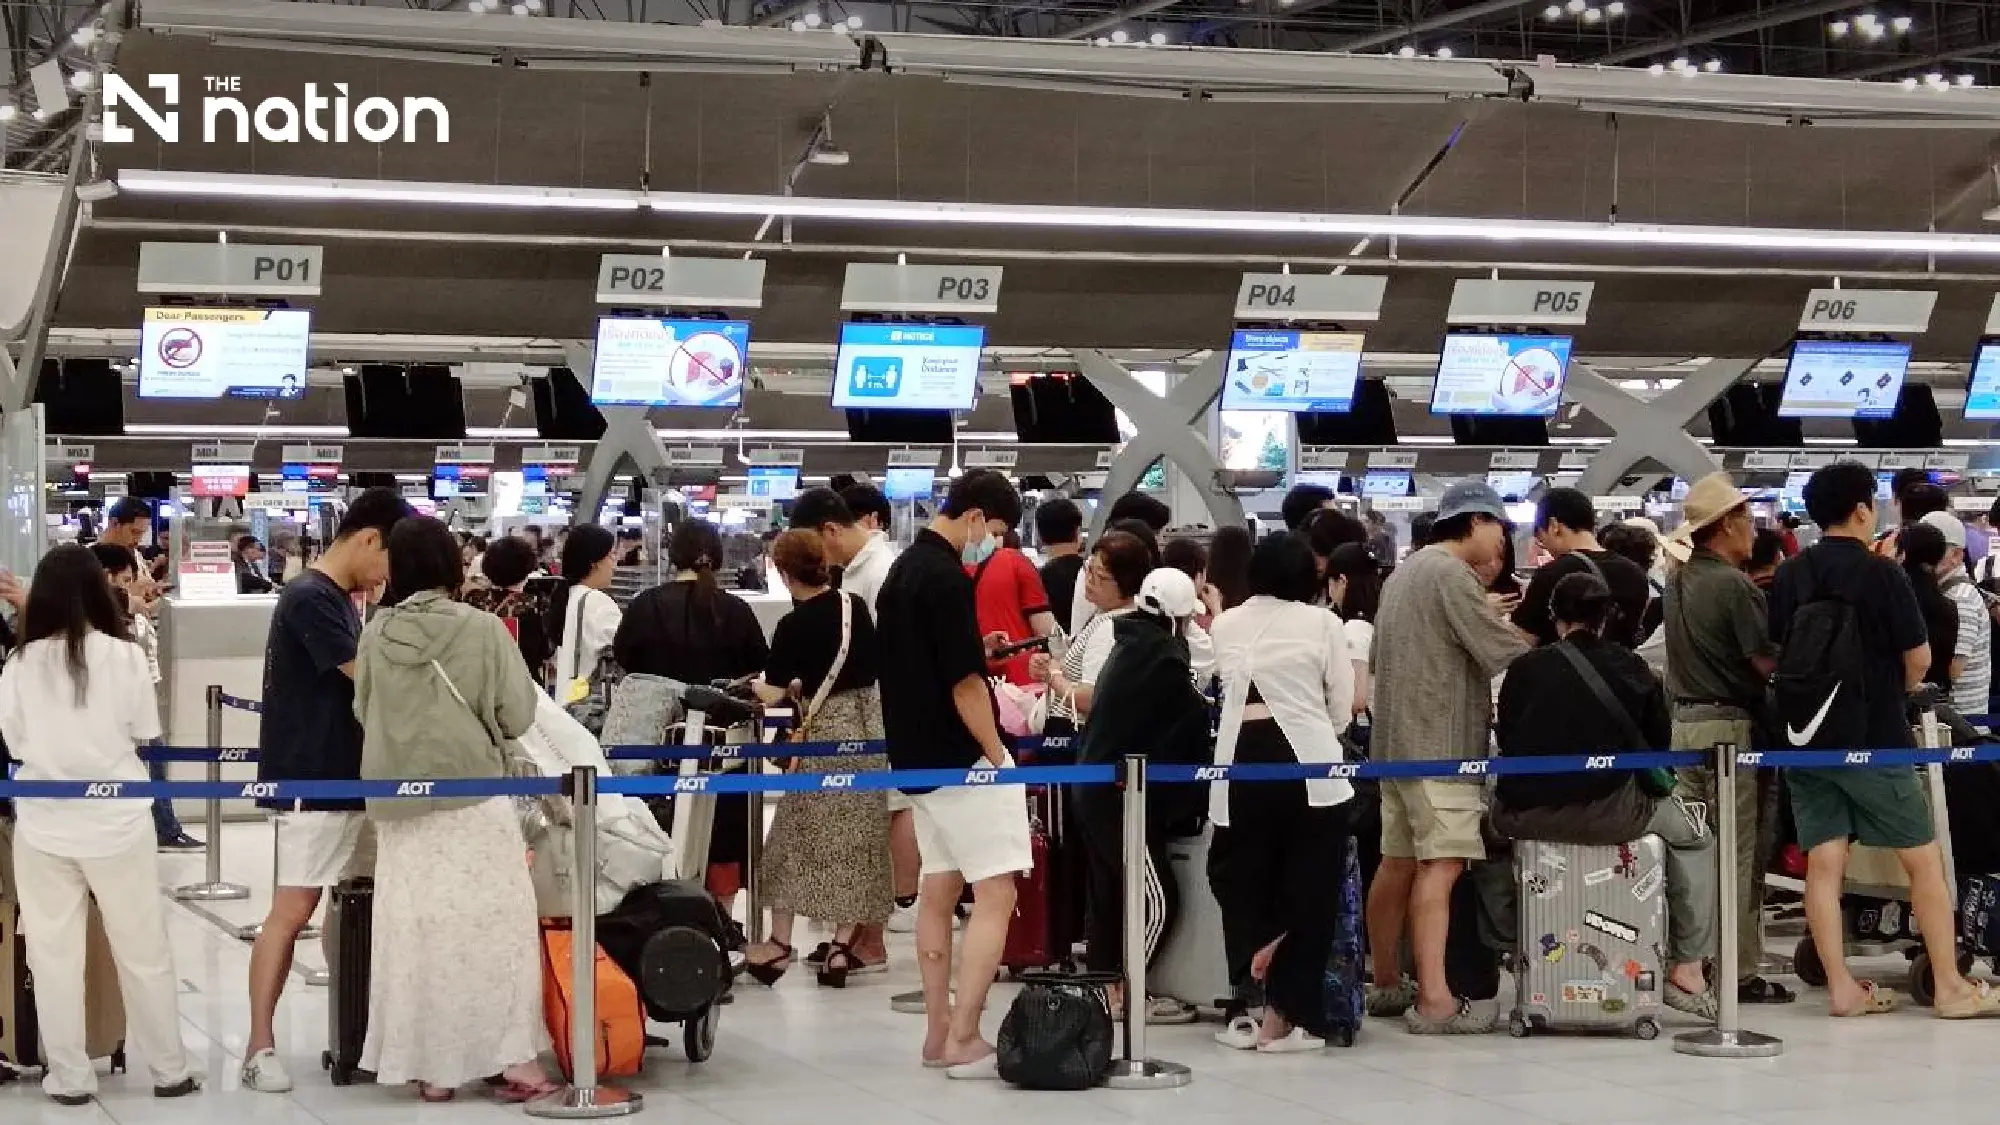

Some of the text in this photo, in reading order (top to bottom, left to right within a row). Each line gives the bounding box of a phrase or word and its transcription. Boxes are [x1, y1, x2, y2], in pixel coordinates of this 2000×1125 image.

[254, 256, 309, 281] P01
[610, 266, 665, 290] P02
[937, 277, 989, 300] P03
[1248, 284, 1296, 306] P04
[1533, 291, 1582, 312] P05
[156, 310, 246, 323] Dear Passengers
[1811, 300, 1857, 320] P06
[196, 448, 218, 457] M04
[837, 741, 867, 753] AOT
[1042, 736, 1071, 747] AOT
[218, 748, 249, 760] AOT
[710, 745, 741, 757] AOT
[1951, 747, 1976, 760] AOT
[1585, 756, 1616, 769] AOT
[1736, 752, 1764, 764] AOT
[1845, 752, 1873, 764] AOT
[1194, 767, 1229, 780] AOT
[1328, 764, 1361, 777] AOT
[1459, 761, 1491, 774] AOT
[673, 776, 709, 791] AOT
[821, 773, 856, 787] AOT
[964, 770, 999, 784] AOT
[85, 782, 123, 797] AOT
[241, 782, 278, 798] AOT
[396, 781, 435, 795] AOT
